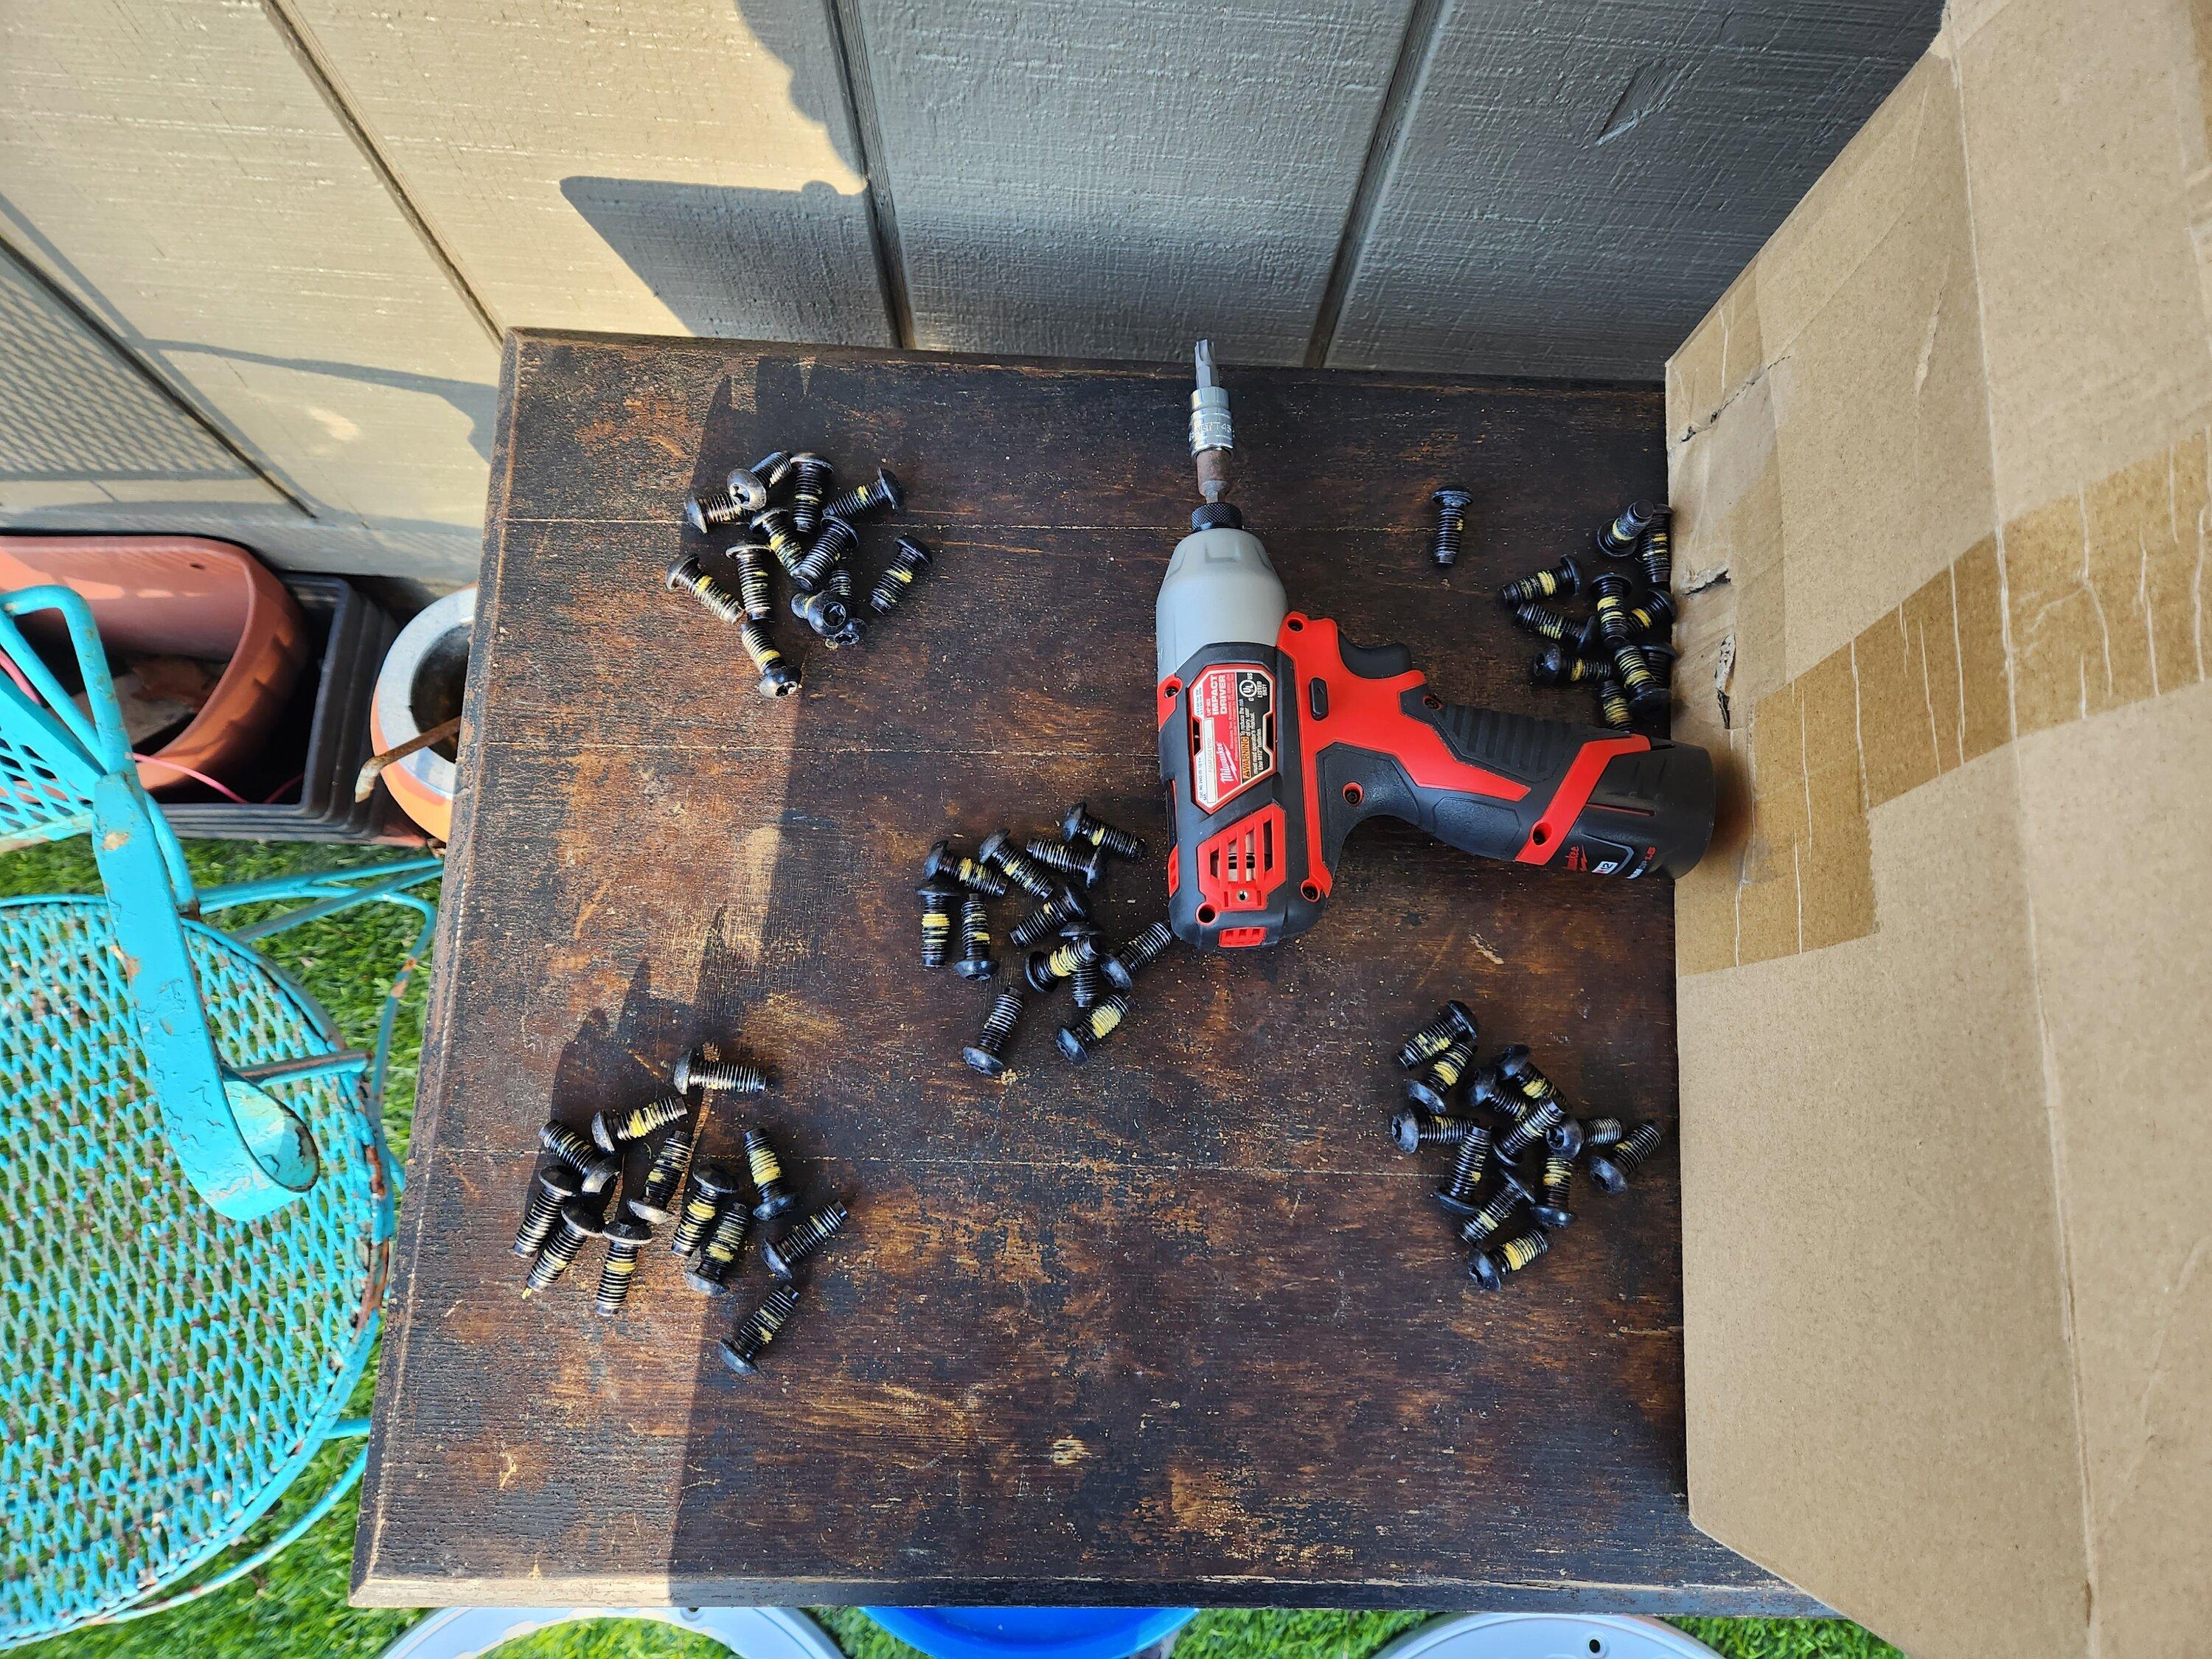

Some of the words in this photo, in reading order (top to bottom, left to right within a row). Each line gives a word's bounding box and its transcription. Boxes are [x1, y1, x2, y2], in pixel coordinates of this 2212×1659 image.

[1210, 675, 1219, 714] IMPACT
[1219, 675, 1228, 714] DRIVER
[1242, 684, 1253, 693] UL
[1216, 742, 1234, 784] Milwaukee
[1241, 737, 1250, 771] WARNING
